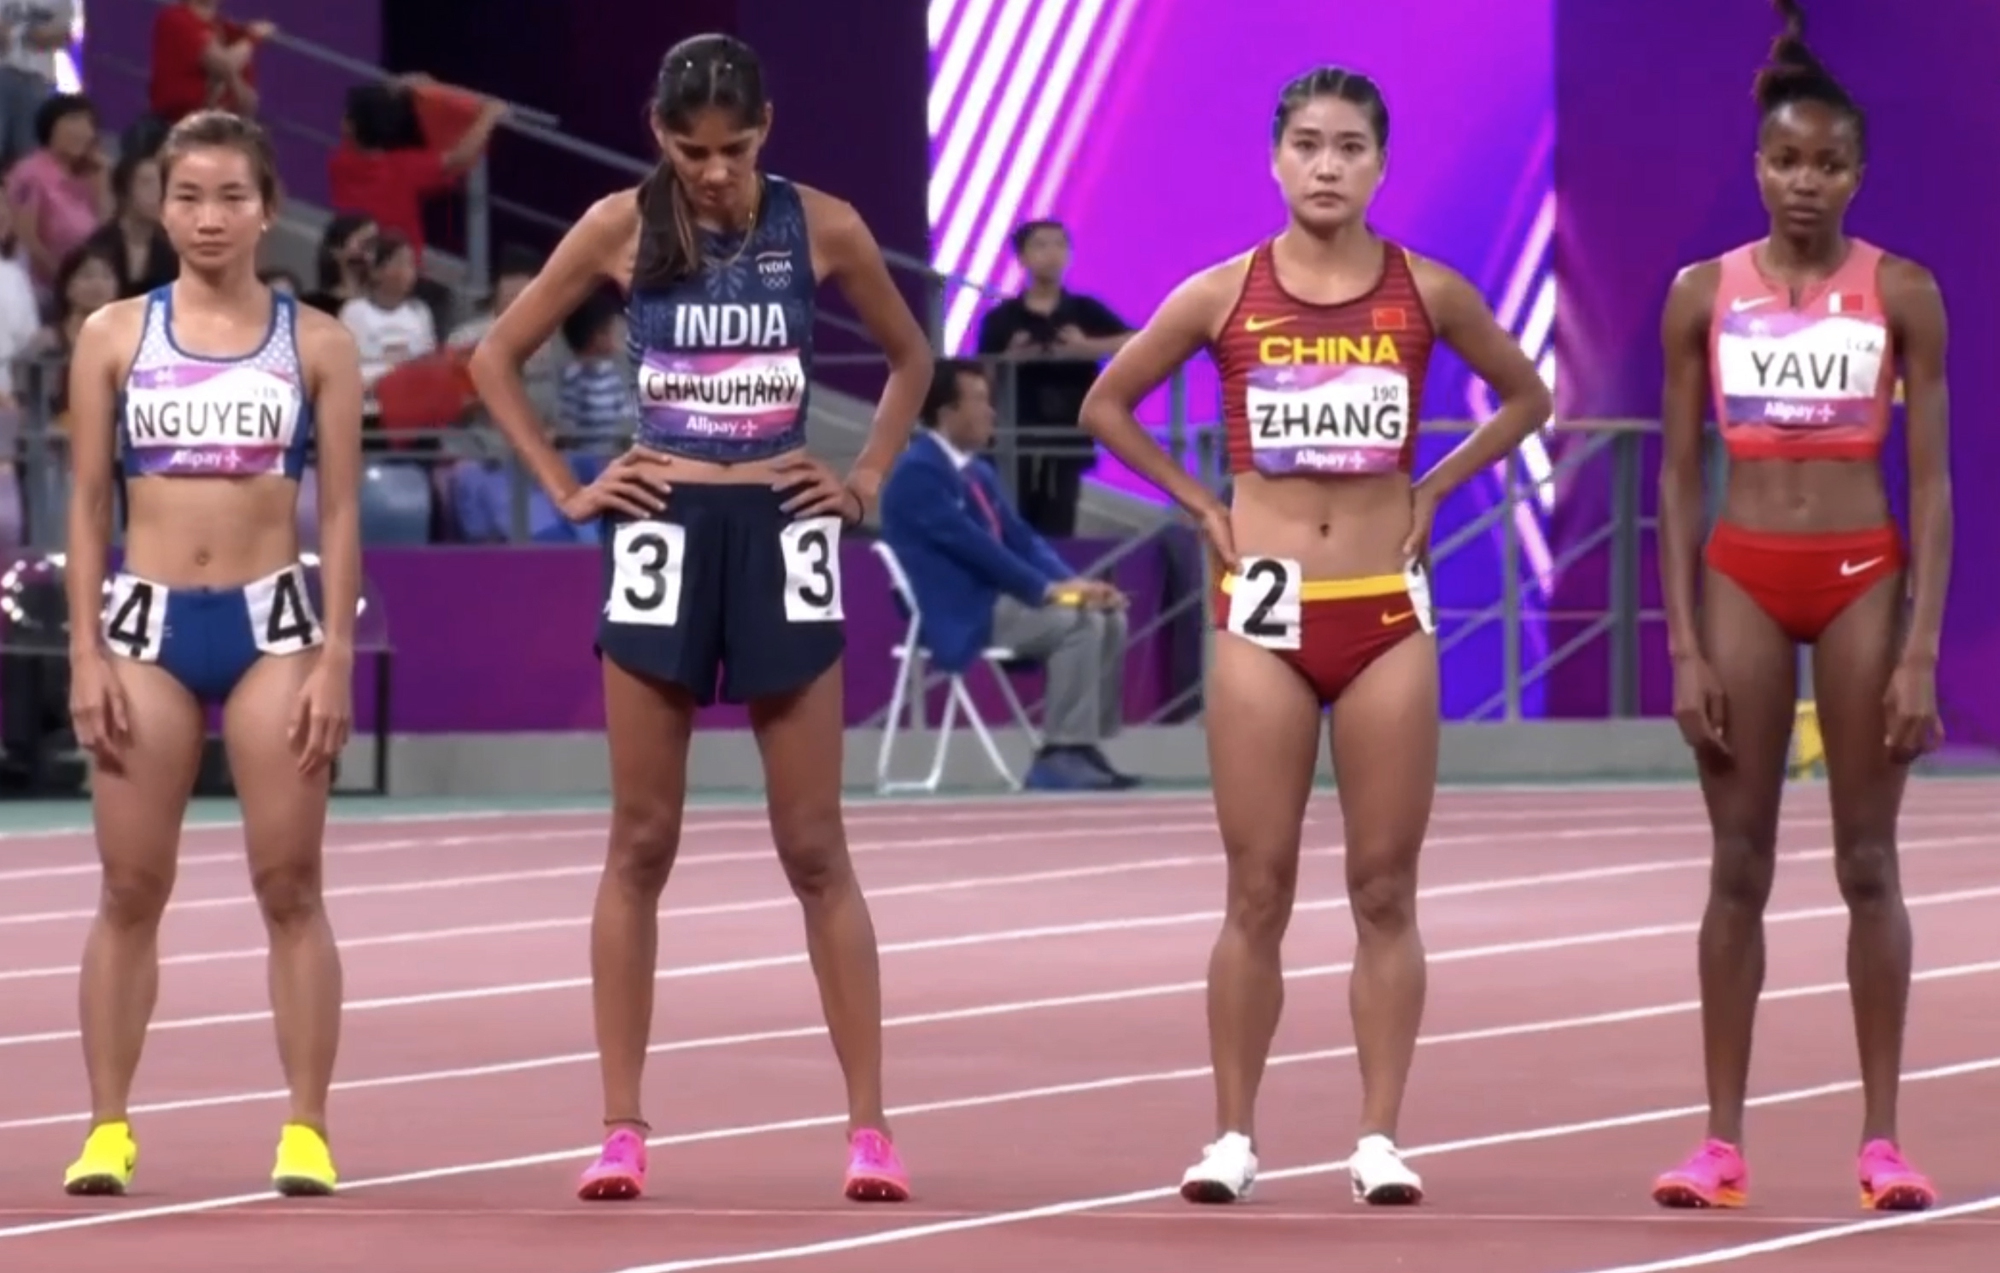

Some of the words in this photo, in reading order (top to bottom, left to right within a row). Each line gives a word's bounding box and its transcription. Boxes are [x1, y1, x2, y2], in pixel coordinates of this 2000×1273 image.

[758, 260, 793, 274] INDIA
[674, 303, 788, 347] INDIA
[1259, 334, 1400, 366] CHINA
[1751, 351, 1849, 391] YAVI
[647, 373, 799, 407] CHAUDHARY
[134, 401, 283, 439] NGUYEN
[686, 415, 739, 434] Alipay
[1256, 403, 1401, 440] ZHANG
[1764, 401, 1816, 421] Alipay
[170, 450, 223, 468] Alipay
[1295, 449, 1347, 468] Alipay
[624, 533, 669, 611] 3
[797, 530, 834, 608] 3
[267, 571, 313, 646] 4
[1243, 559, 1288, 636] 2
[108, 582, 153, 658] 4
